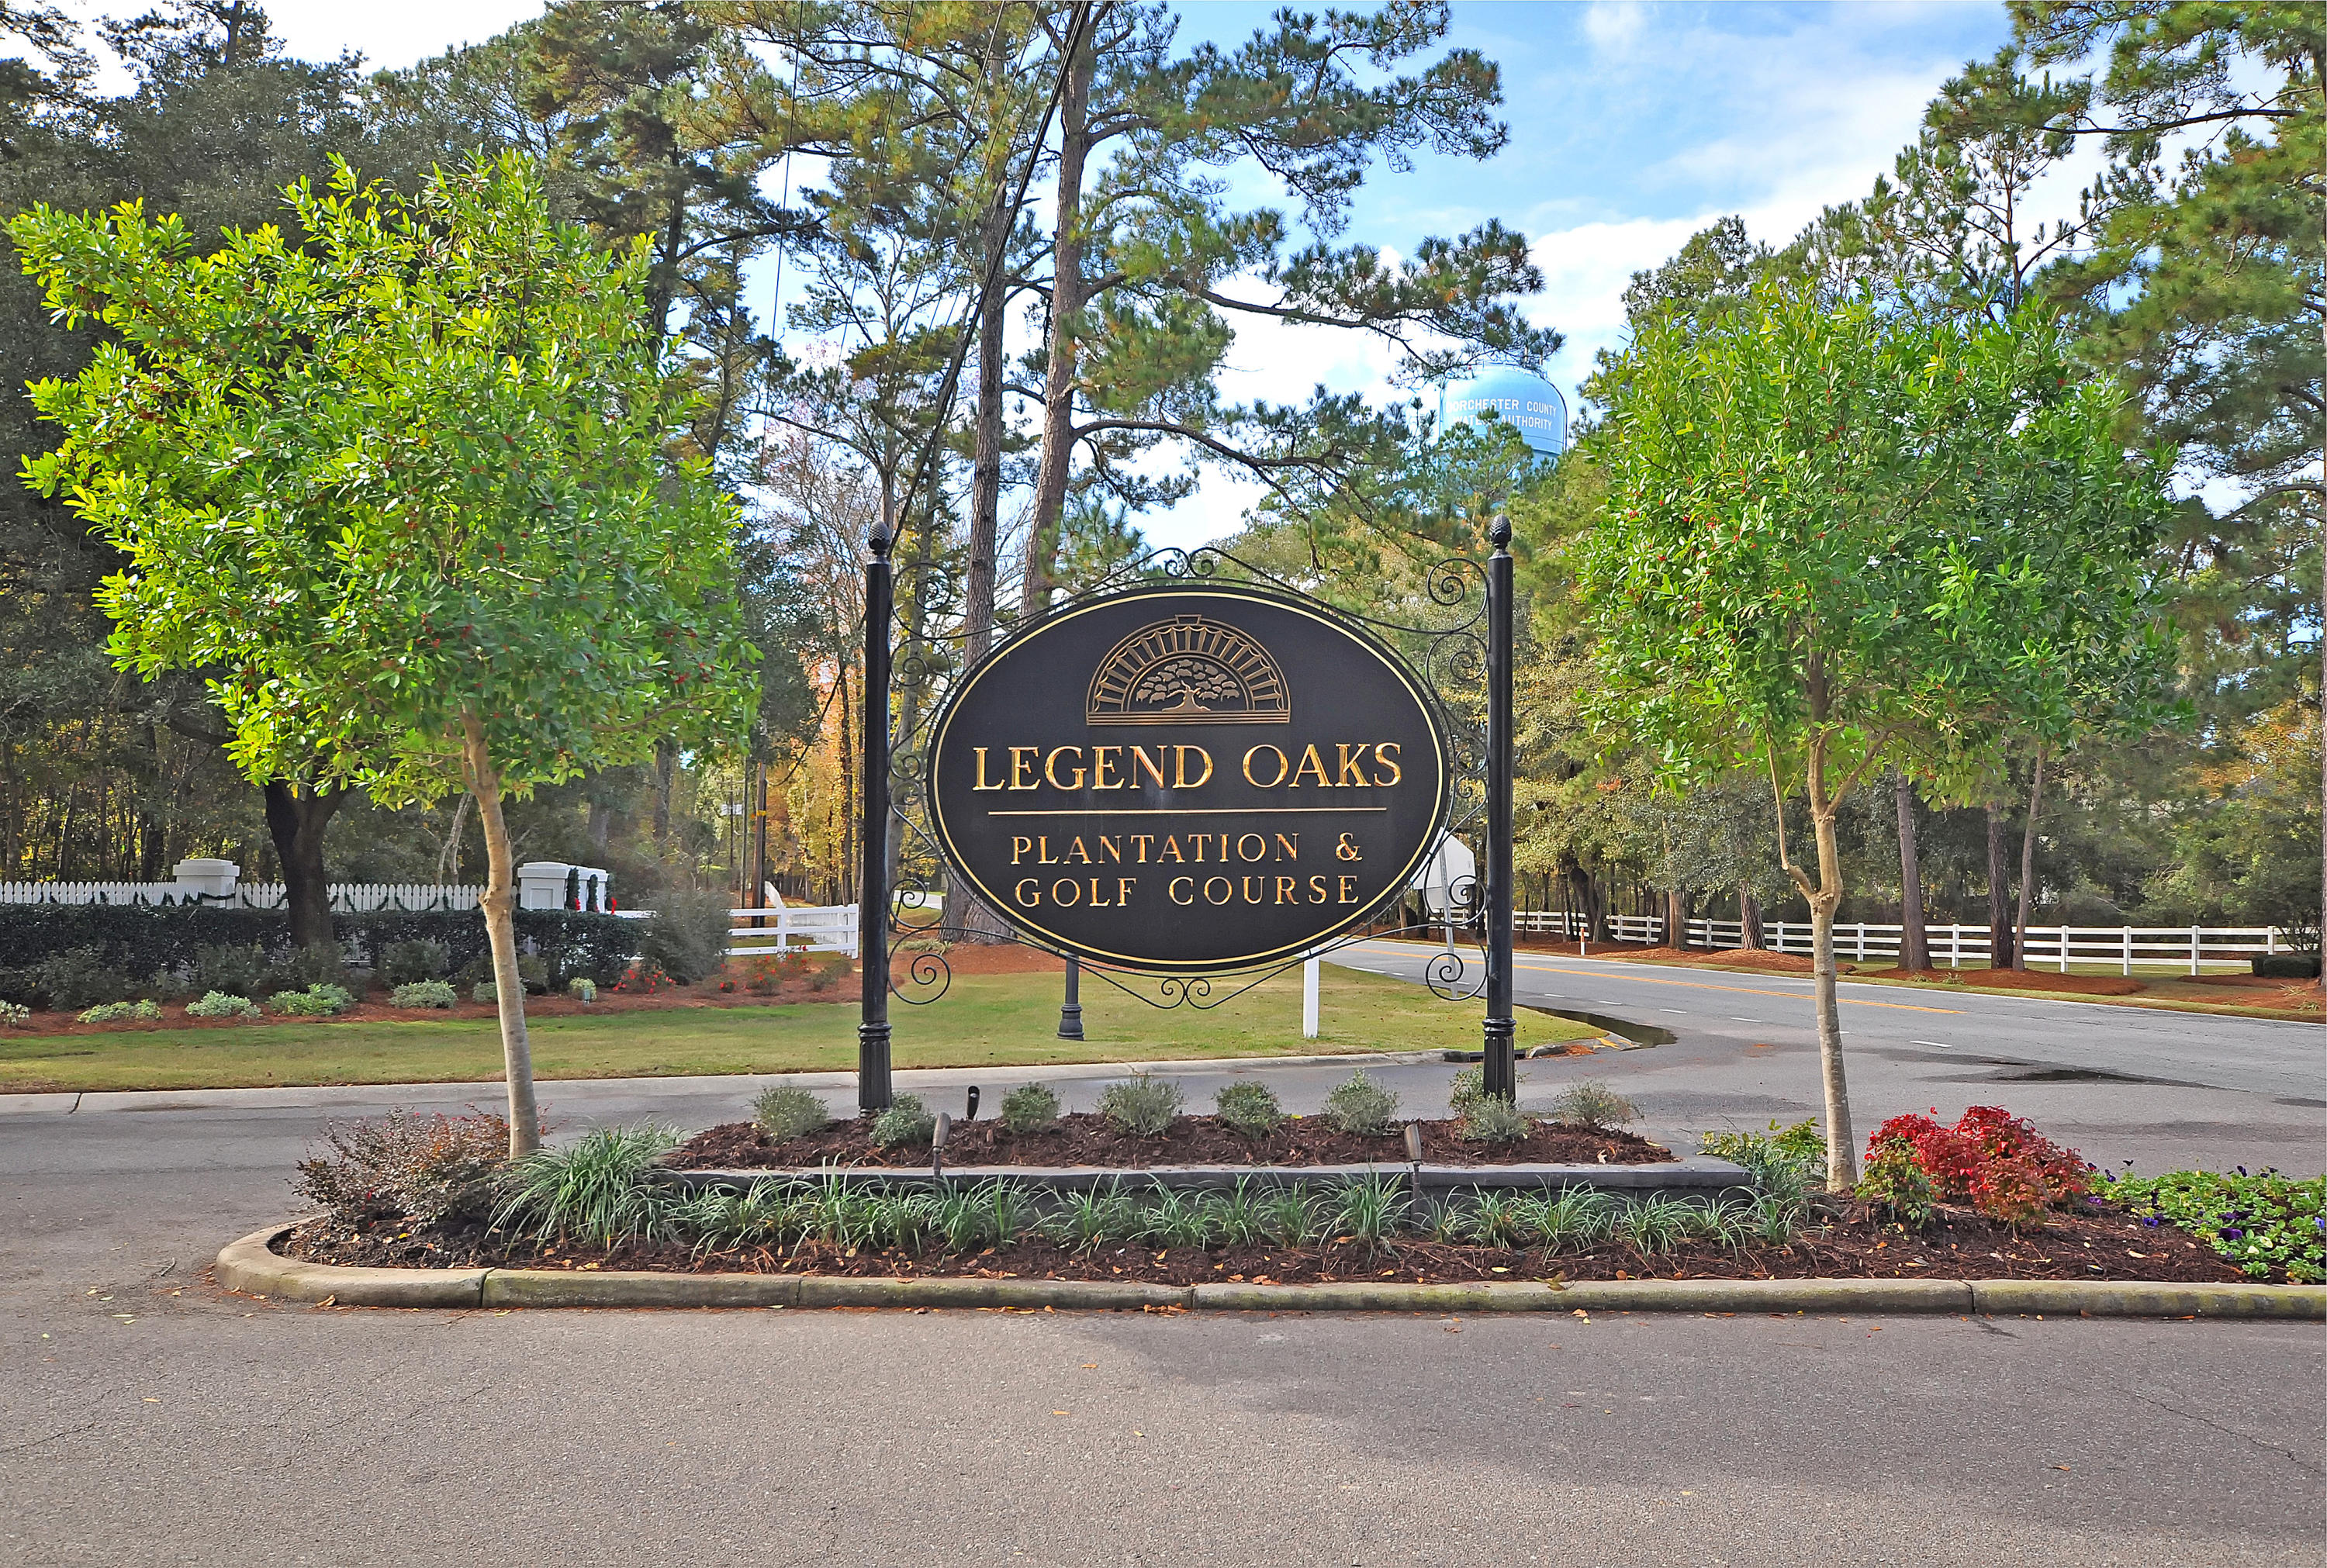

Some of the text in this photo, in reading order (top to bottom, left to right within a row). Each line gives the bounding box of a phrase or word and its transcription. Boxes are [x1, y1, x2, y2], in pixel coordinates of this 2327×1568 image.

[1446, 399, 1557, 417] DORCHESTER COUNTY
[1453, 414, 1552, 431] WATE AUTHORITY
[972, 742, 1402, 790] LEGEND OAKS
[1011, 831, 1363, 865] PLANTATION &
[1015, 875, 1359, 907] GOLF COURSE
